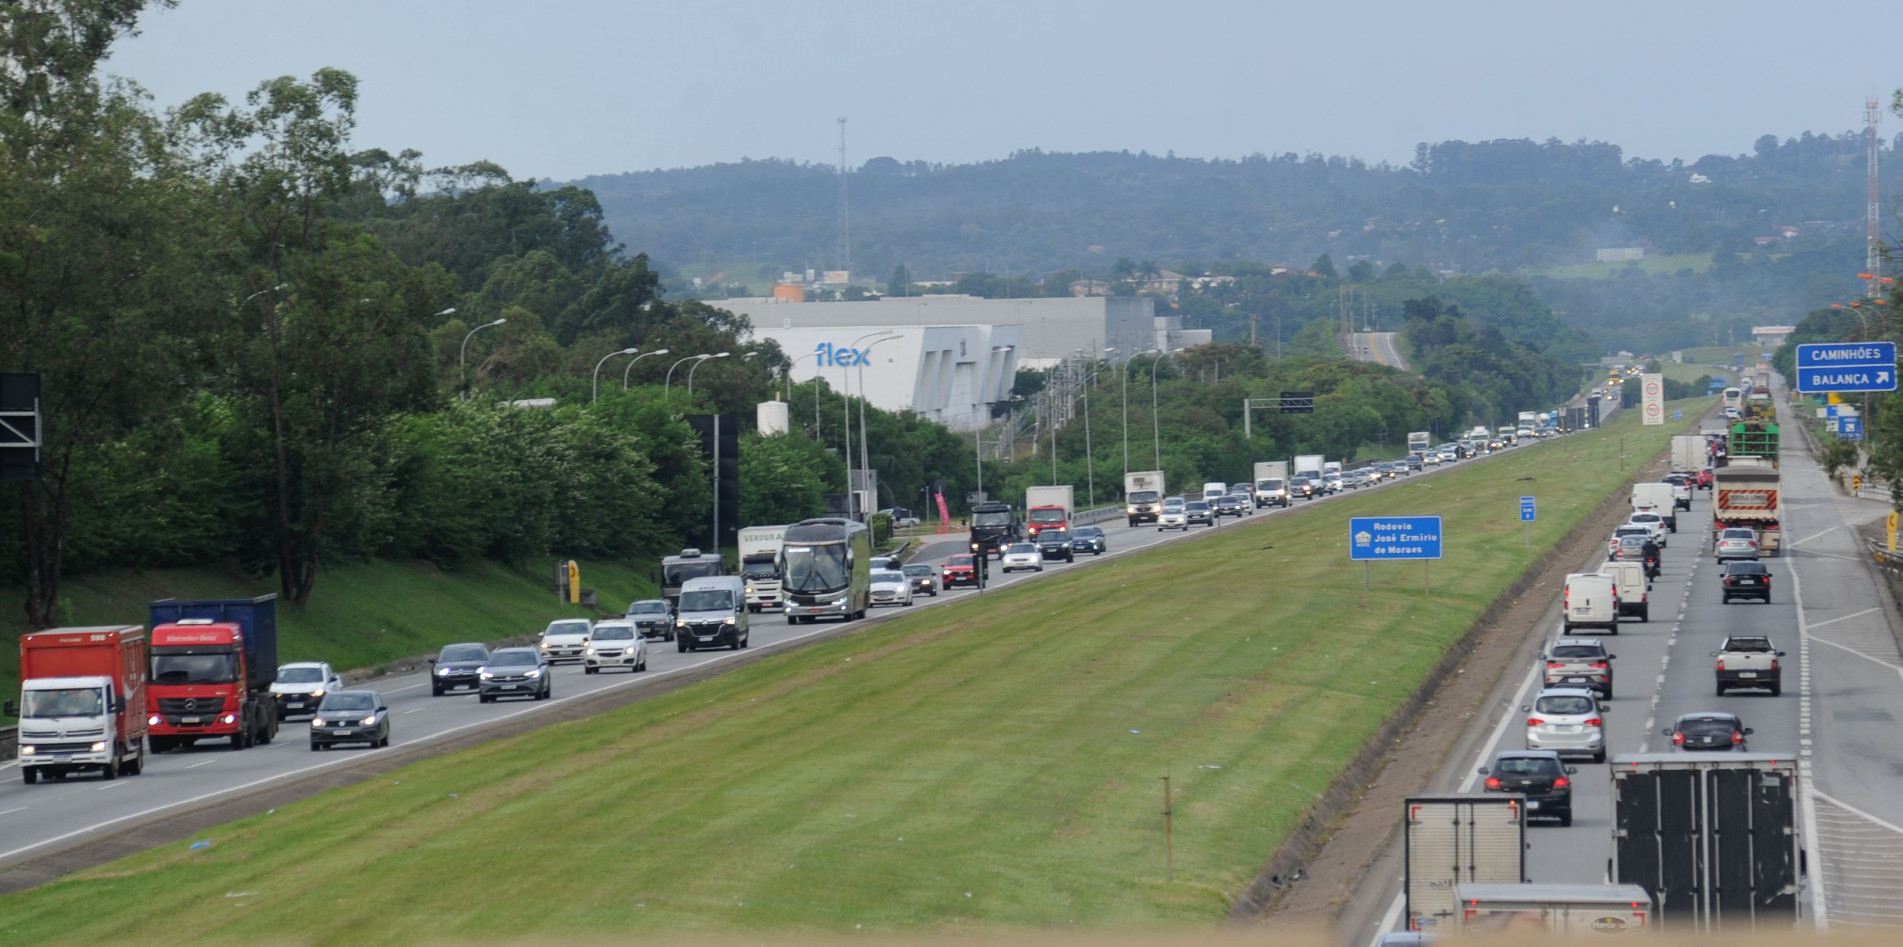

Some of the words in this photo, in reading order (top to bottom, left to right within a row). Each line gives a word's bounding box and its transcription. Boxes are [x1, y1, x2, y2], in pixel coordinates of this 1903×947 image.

[816, 342, 870, 367] flex
[1812, 347, 1881, 360] CAMINHÕES
[1813, 374, 1869, 385] BALANÇA
[1374, 522, 1412, 530] Rodovia
[1374, 533, 1397, 542] José
[1374, 546, 1386, 554] de
[1388, 546, 1422, 554] Moraes
[166, 634, 217, 642] Mercedes-Benz
